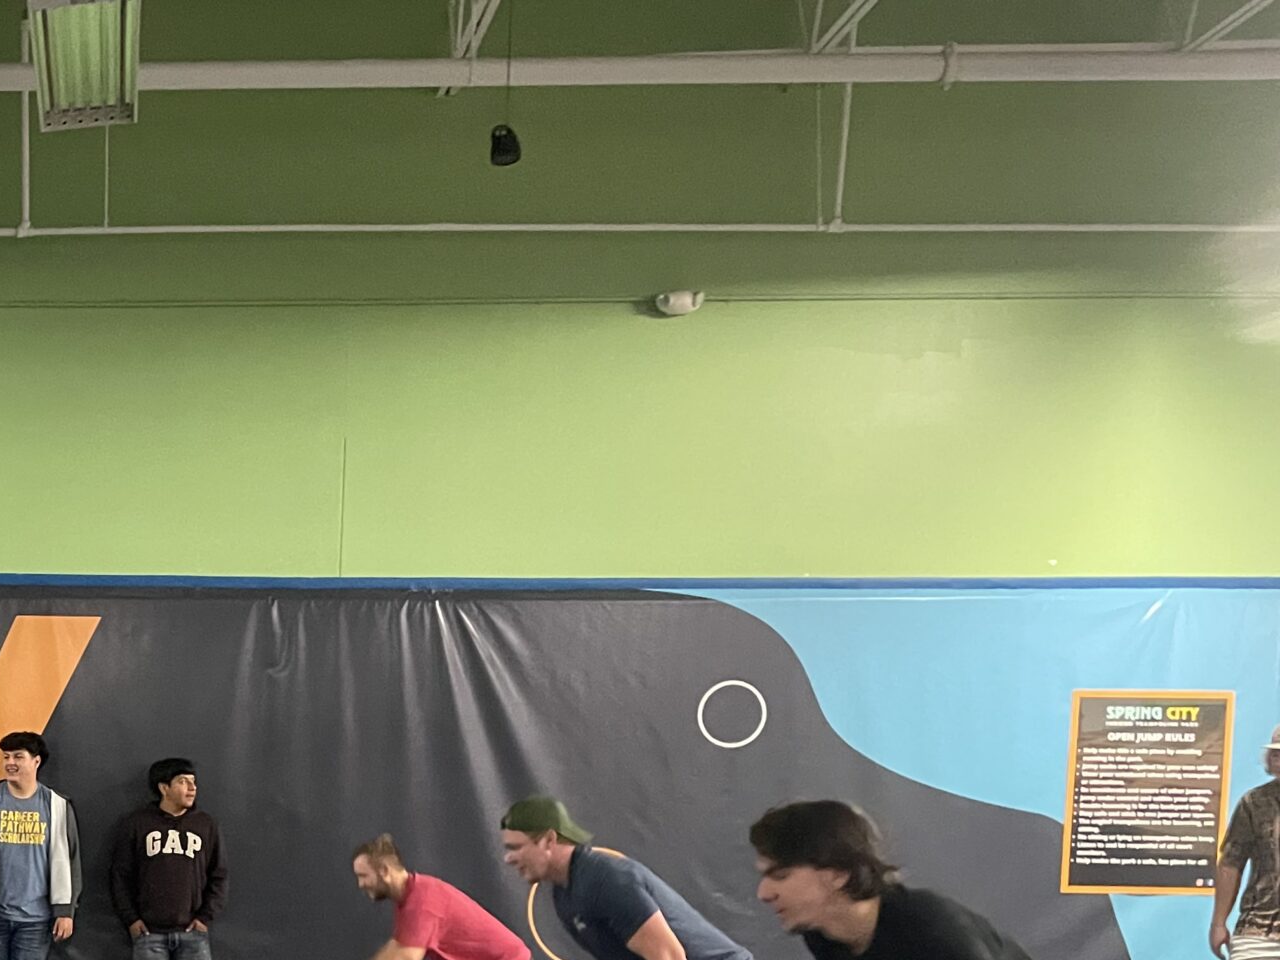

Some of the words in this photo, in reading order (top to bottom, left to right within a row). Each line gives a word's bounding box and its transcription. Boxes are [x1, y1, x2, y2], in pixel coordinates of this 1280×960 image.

[1106, 706, 1162, 720] SPRING
[1166, 706, 1200, 721] CITY
[1107, 732, 1136, 741] OPEN
[0, 810, 40, 822] CAREER
[0, 821, 47, 834] PATHWAY
[146, 829, 202, 859] GAP
